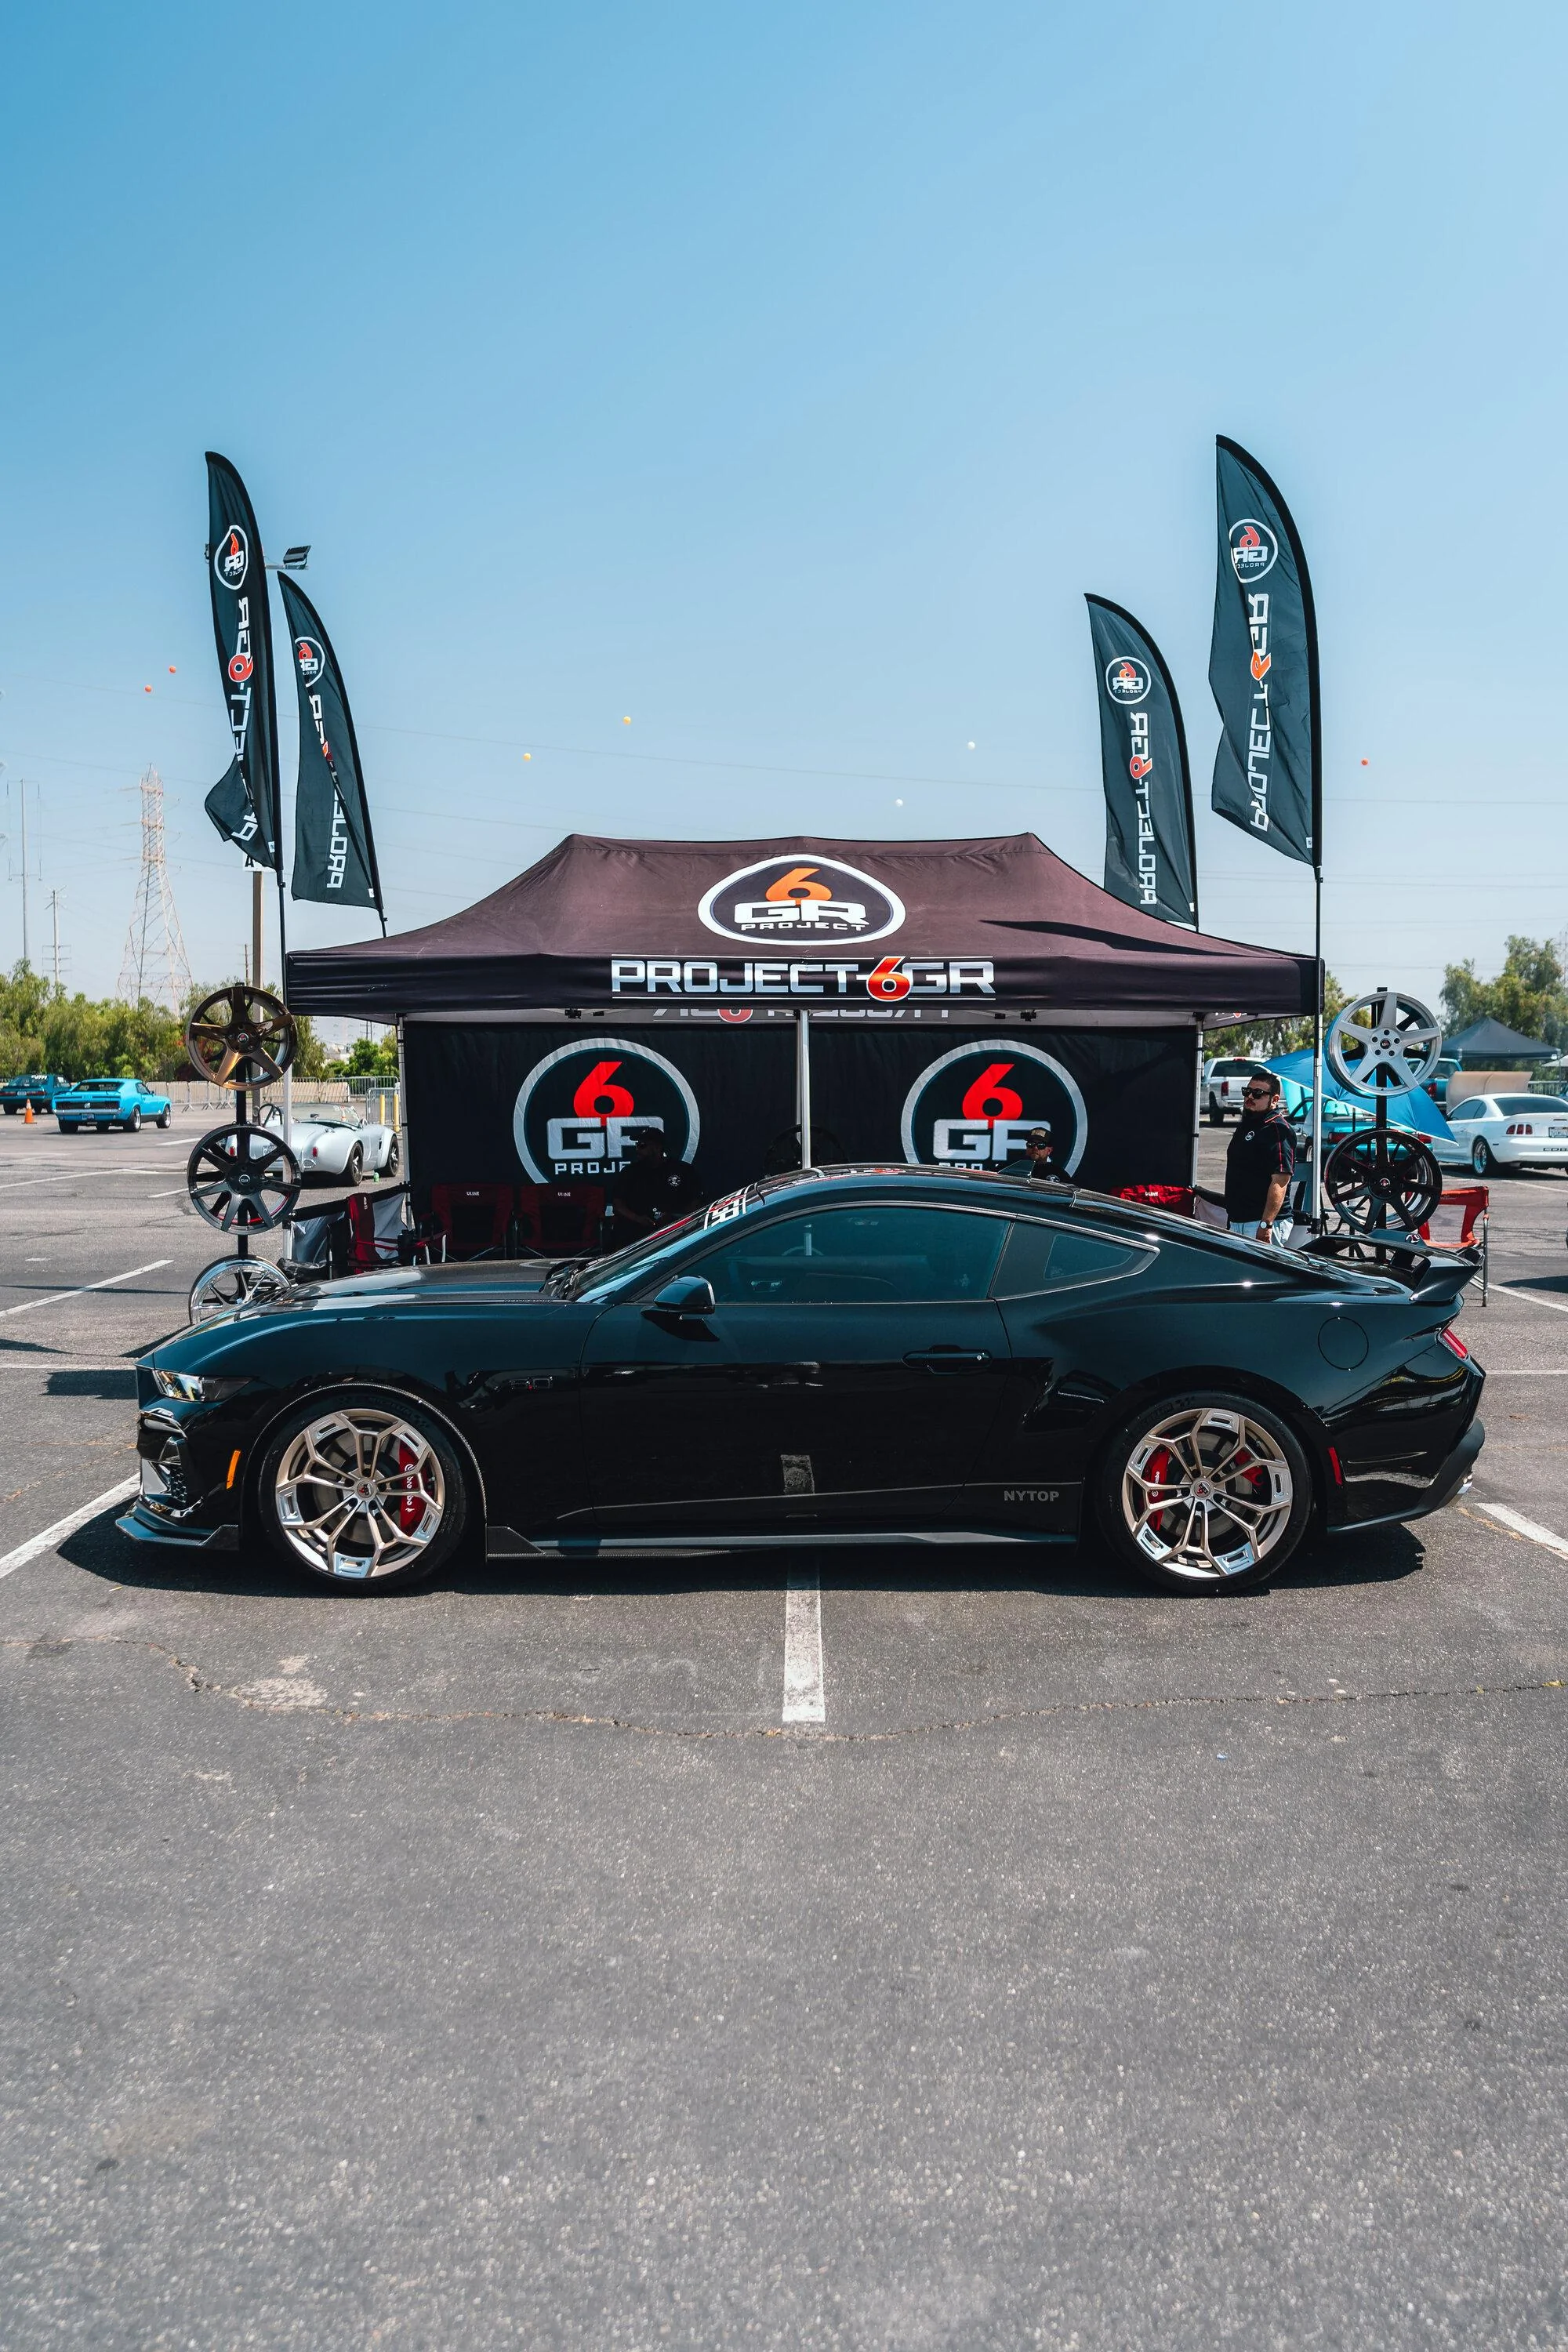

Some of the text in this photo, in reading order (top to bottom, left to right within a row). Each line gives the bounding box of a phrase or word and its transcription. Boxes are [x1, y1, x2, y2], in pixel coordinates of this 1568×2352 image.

[765, 867, 833, 906] 6
[734, 899, 870, 926] GR
[741, 921, 866, 932] PROJECT
[573, 1062, 634, 1123] 6
[962, 1063, 1023, 1127] 6
[1003, 1490, 1060, 1502] NYTOP
